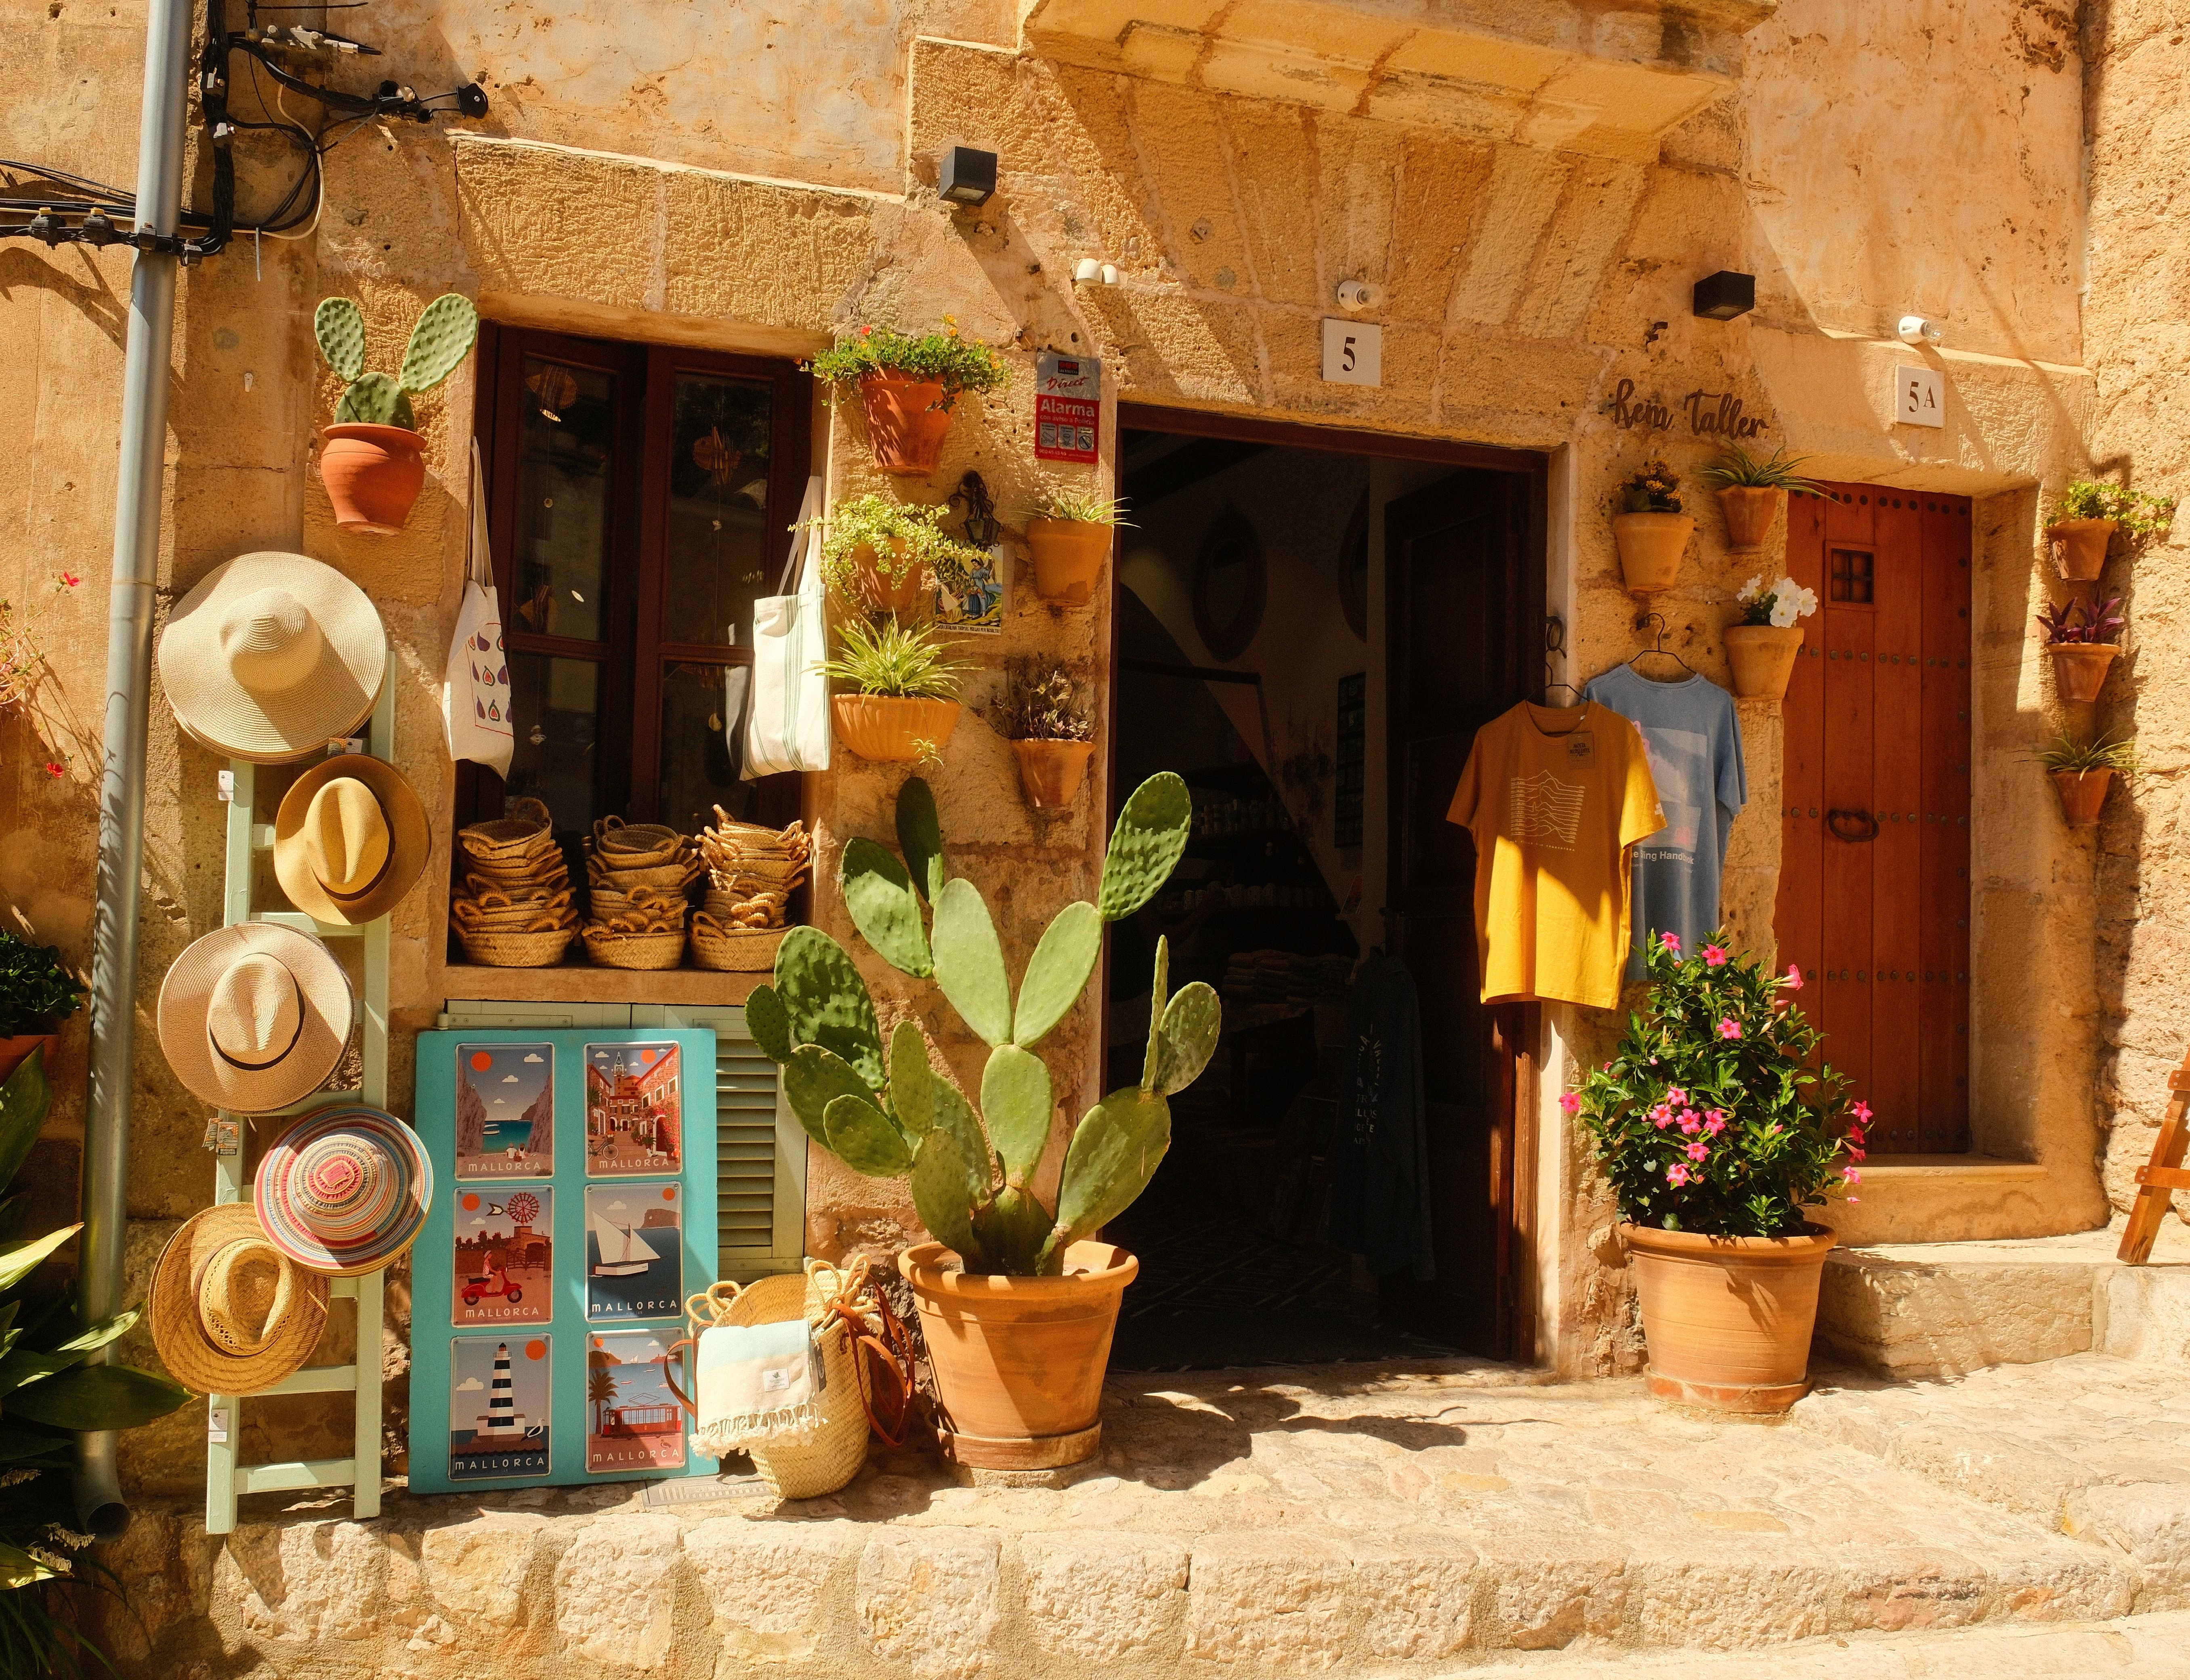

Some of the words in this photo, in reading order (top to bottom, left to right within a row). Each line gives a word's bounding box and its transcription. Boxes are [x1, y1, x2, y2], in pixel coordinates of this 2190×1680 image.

[1343, 336, 1356, 372] 5
[1047, 376, 1090, 391] Direct
[1040, 399, 1094, 417] Alarma
[1614, 378, 1674, 432] Rem
[1683, 388, 1770, 440] Taller
